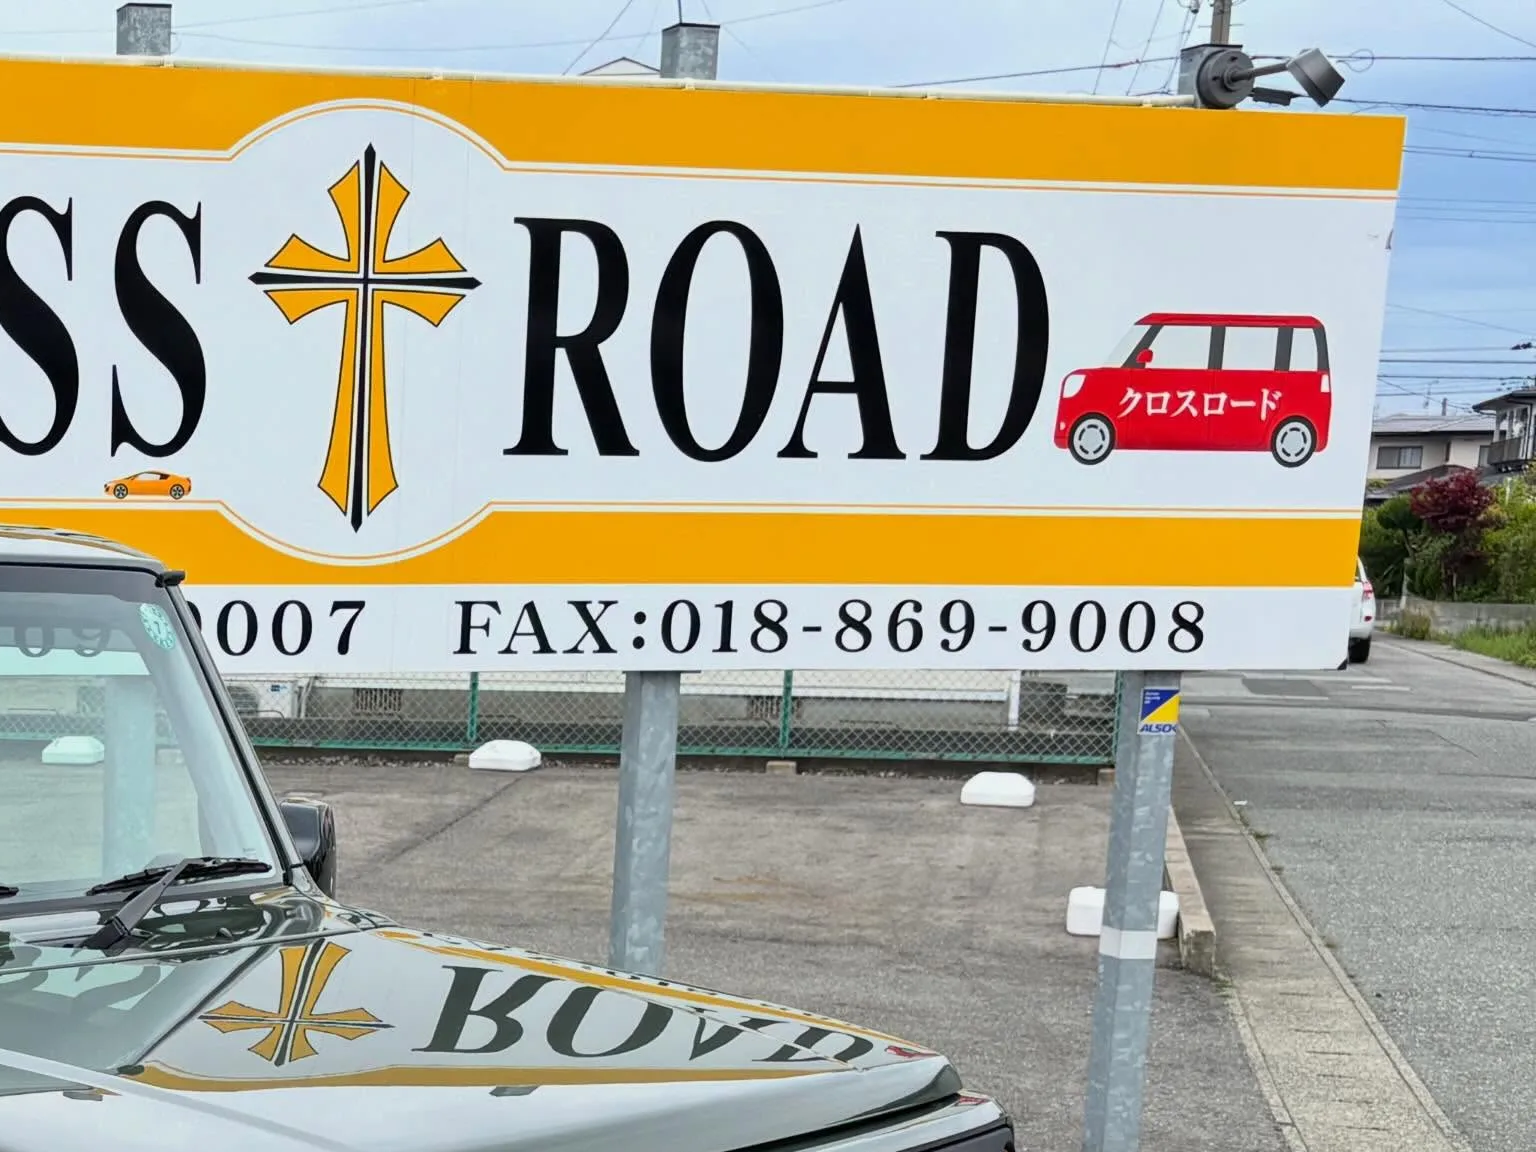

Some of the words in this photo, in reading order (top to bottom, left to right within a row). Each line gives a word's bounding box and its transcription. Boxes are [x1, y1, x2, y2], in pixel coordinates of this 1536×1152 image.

[503, 216, 1050, 463] ROAD
[1117, 387, 1284, 421] クロスロード
[186, 599, 366, 656] 007
[453, 599, 1206, 655] FAX:018-869-9008
